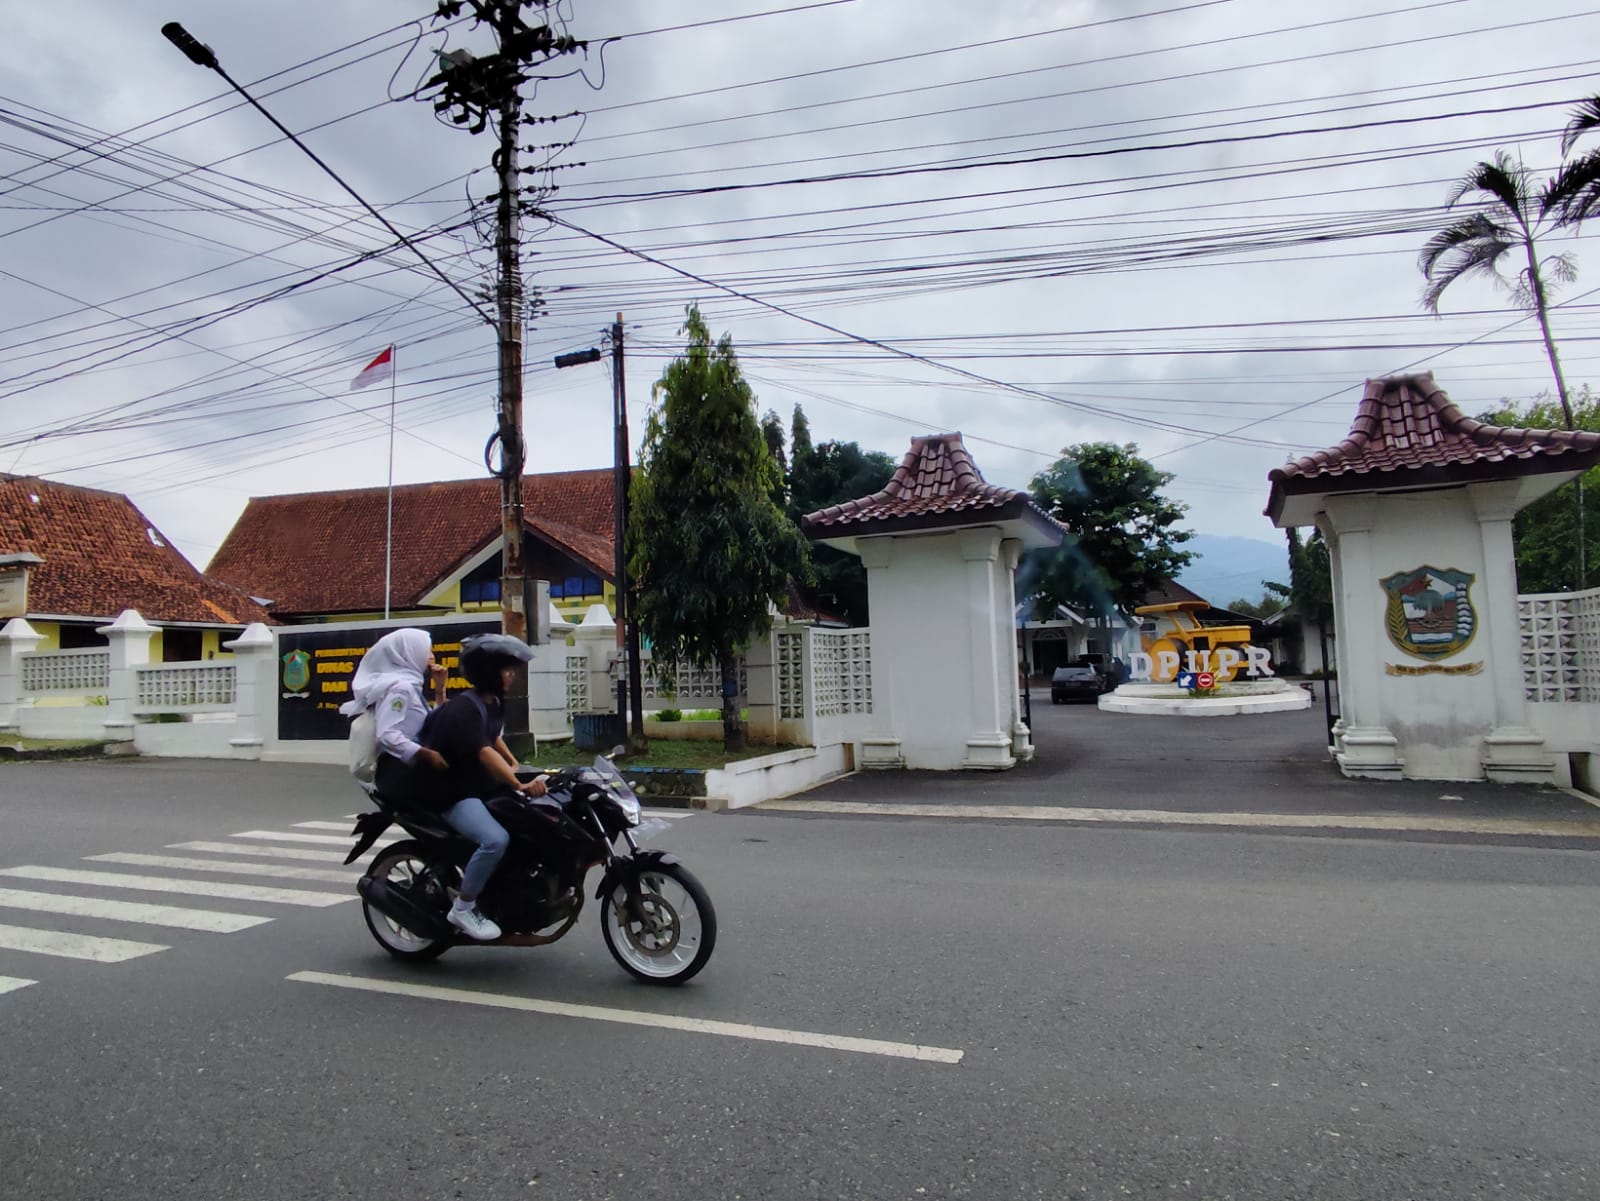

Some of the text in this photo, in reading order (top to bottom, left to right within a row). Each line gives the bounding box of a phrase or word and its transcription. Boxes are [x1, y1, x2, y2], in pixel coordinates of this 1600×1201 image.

[317, 662, 354, 673] DINAS
[1128, 645, 1275, 680] DPUPR
[322, 681, 348, 692] DAN
